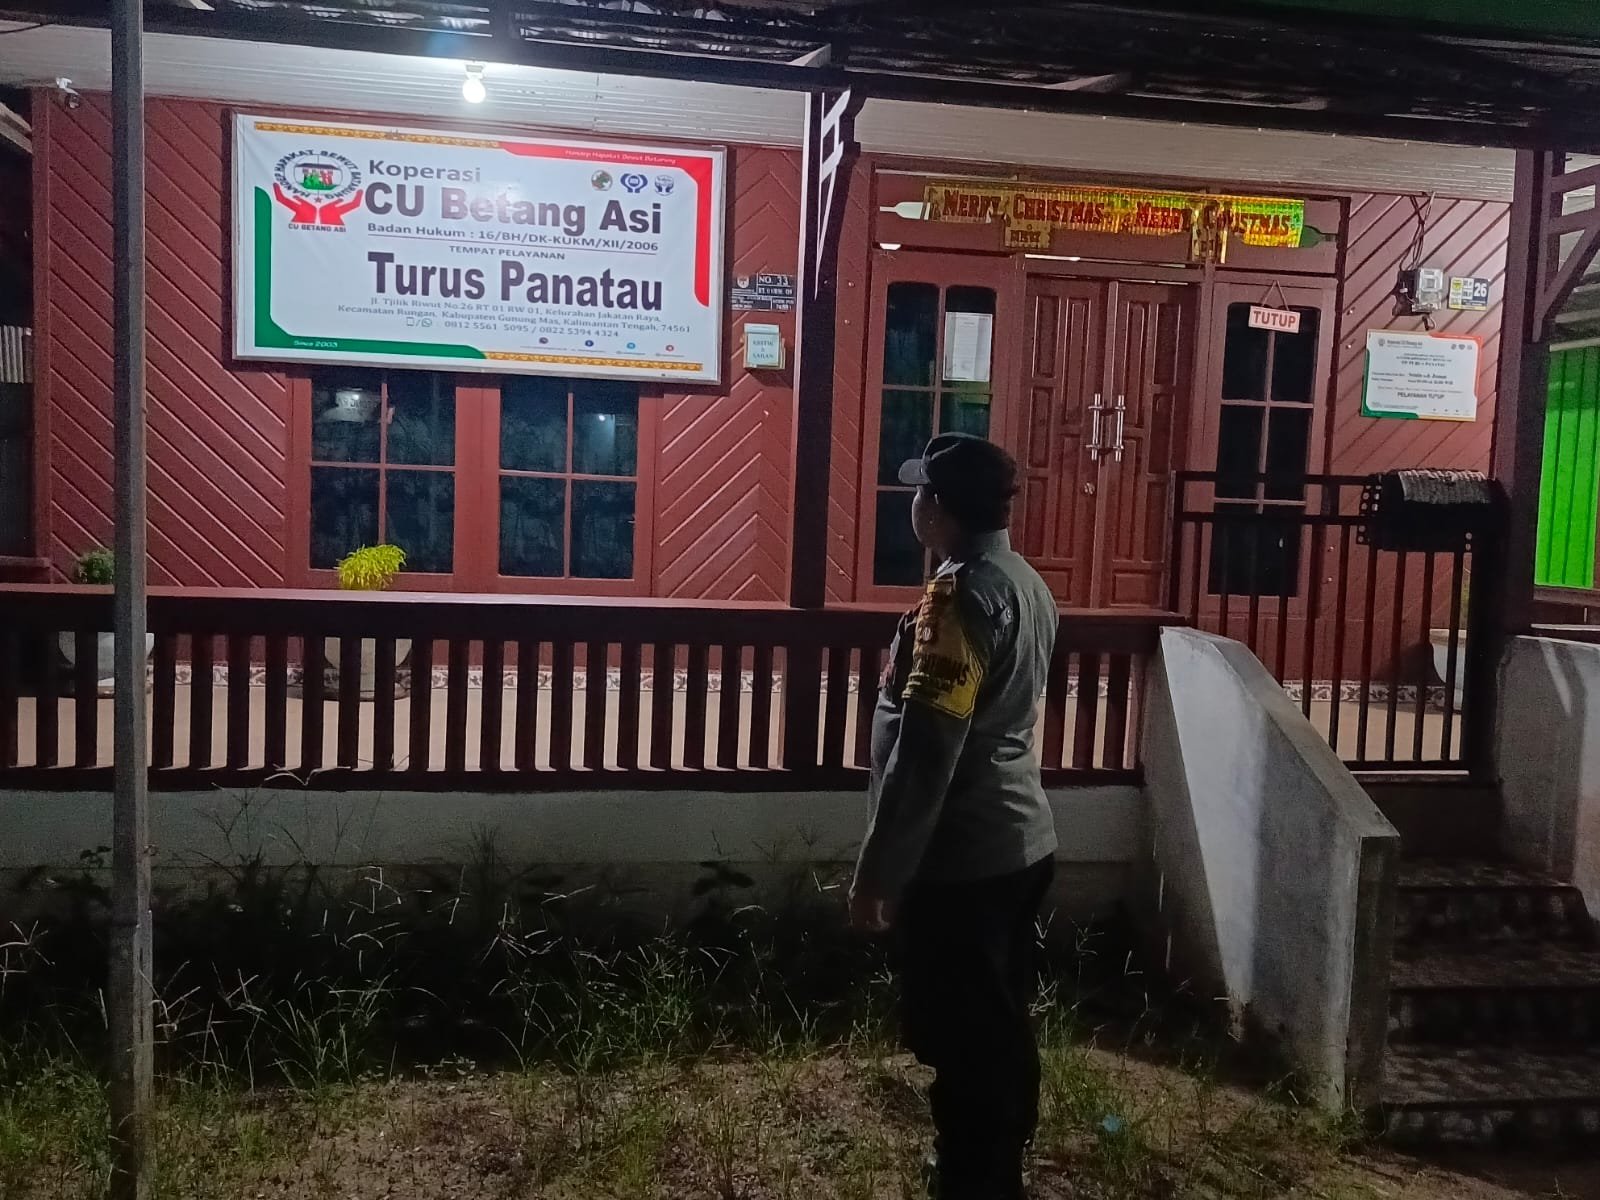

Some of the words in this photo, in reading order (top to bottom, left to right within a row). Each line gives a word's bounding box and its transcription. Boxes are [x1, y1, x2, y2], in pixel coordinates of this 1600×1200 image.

[369, 160, 481, 182] Koperasi
[365, 182, 425, 217] CU
[441, 187, 586, 237] Betang
[600, 200, 661, 234] Asi
[942, 188, 1002, 218] MERRY
[1012, 193, 1105, 225] CHRISTMAS
[301, 224, 332, 232] BETANG
[367, 222, 412, 234] Badan
[416, 226, 466, 238] Hukum
[479, 231, 659, 251] 16/BH/DK-KUKM/XII/2006
[449, 246, 496, 256] TEMPAT
[498, 248, 566, 260] PELAYANAN
[367, 251, 485, 300] Turus
[501, 260, 662, 311] Panatau
[1474, 282, 1488, 297] 26
[337, 304, 395, 315] Kecamatan
[442, 311, 496, 321] Kabupaten
[498, 314, 537, 324] Gunung
[563, 318, 620, 329] Kalimantan
[621, 321, 659, 332] Tengah,
[661, 324, 691, 333] 74561
[411, 300, 441, 309] Riwut
[444, 302, 474, 310] No.26
[476, 304, 491, 312] RT
[507, 305, 525, 313] RW
[545, 308, 596, 318] Kelurahan
[598, 311, 634, 321] Jakatan
[1253, 310, 1296, 328] TUTUP
[472, 322, 497, 331] 5561
